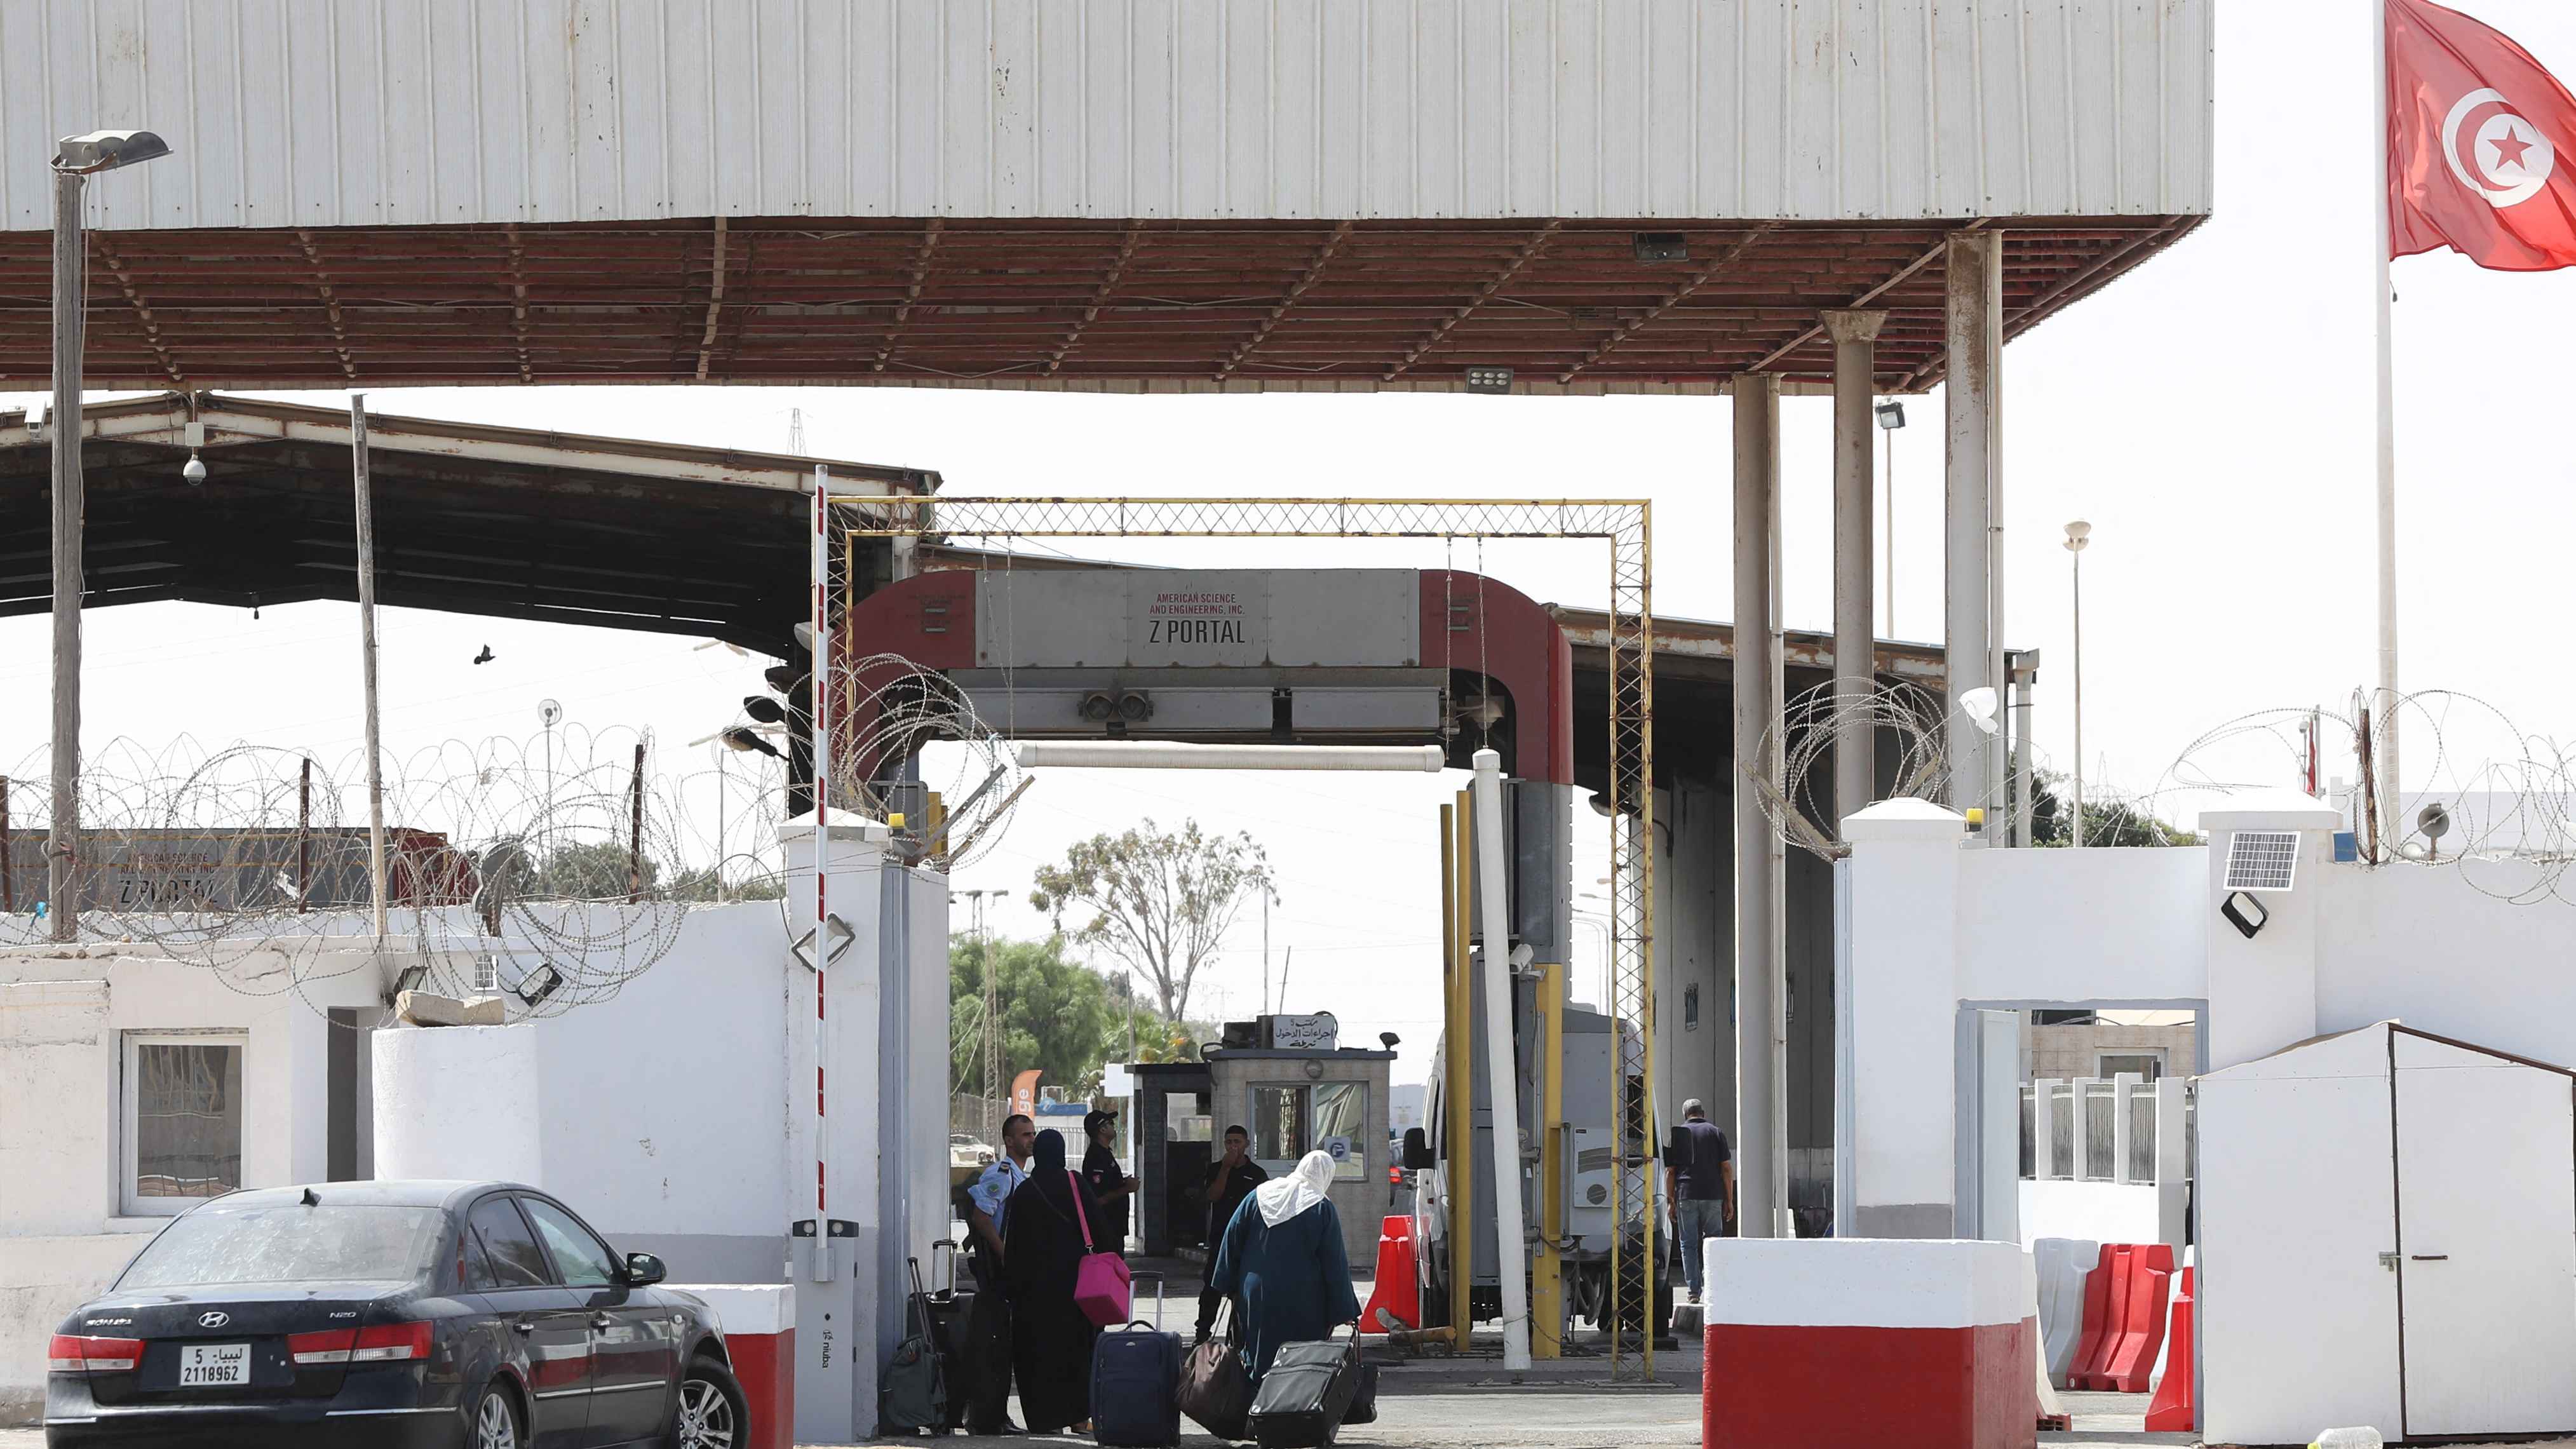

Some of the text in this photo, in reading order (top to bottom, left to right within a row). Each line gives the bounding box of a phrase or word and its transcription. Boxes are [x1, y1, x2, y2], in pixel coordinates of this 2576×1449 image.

[1157, 593, 1236, 603] AMERICAN SCIENCE
[1149, 605, 1245, 615] AND ENGINEERING, INC.
[1149, 620, 1245, 643] Z PORTAL
[1276, 1028, 1301, 1039] الدخول
[195, 1349, 203, 1364] 5
[184, 1366, 238, 1382] 2118962
